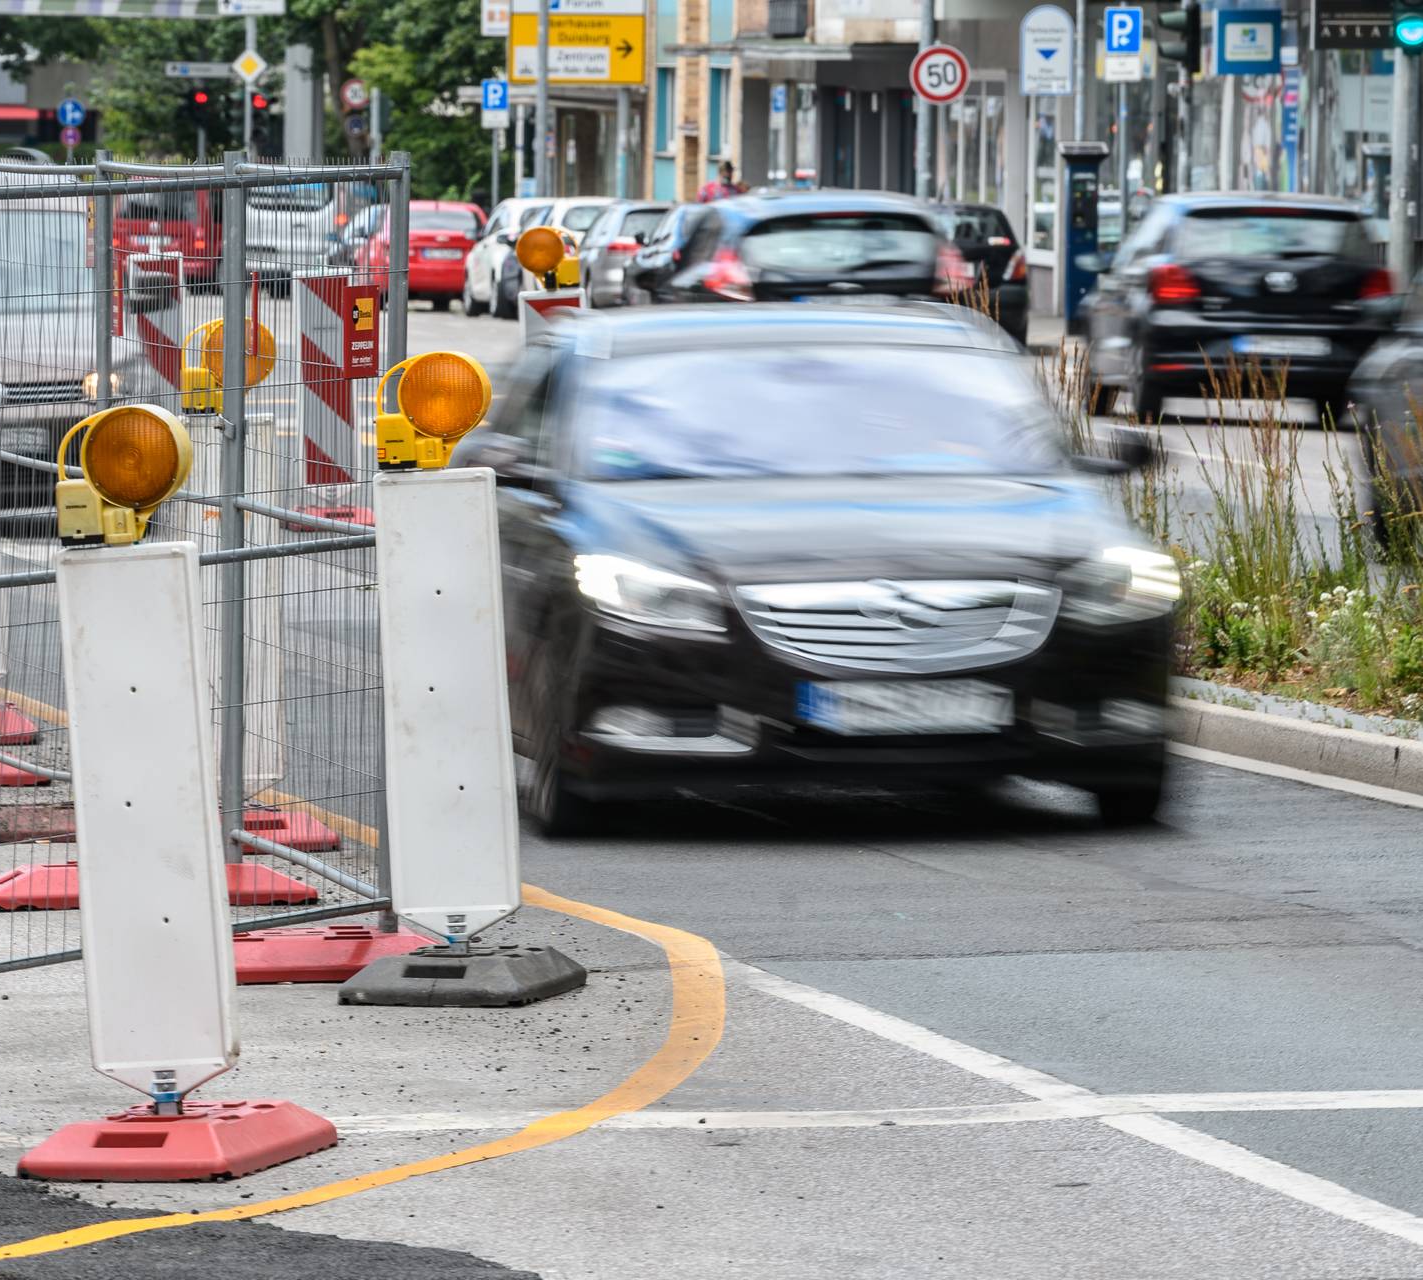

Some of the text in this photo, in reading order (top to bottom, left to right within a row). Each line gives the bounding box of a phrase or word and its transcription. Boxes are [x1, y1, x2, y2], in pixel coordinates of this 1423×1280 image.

[548, 19, 610, 28] berhausen
[558, 32, 610, 45] Duisburg
[557, 49, 605, 60] Zentrum
[928, 62, 957, 88] 50
